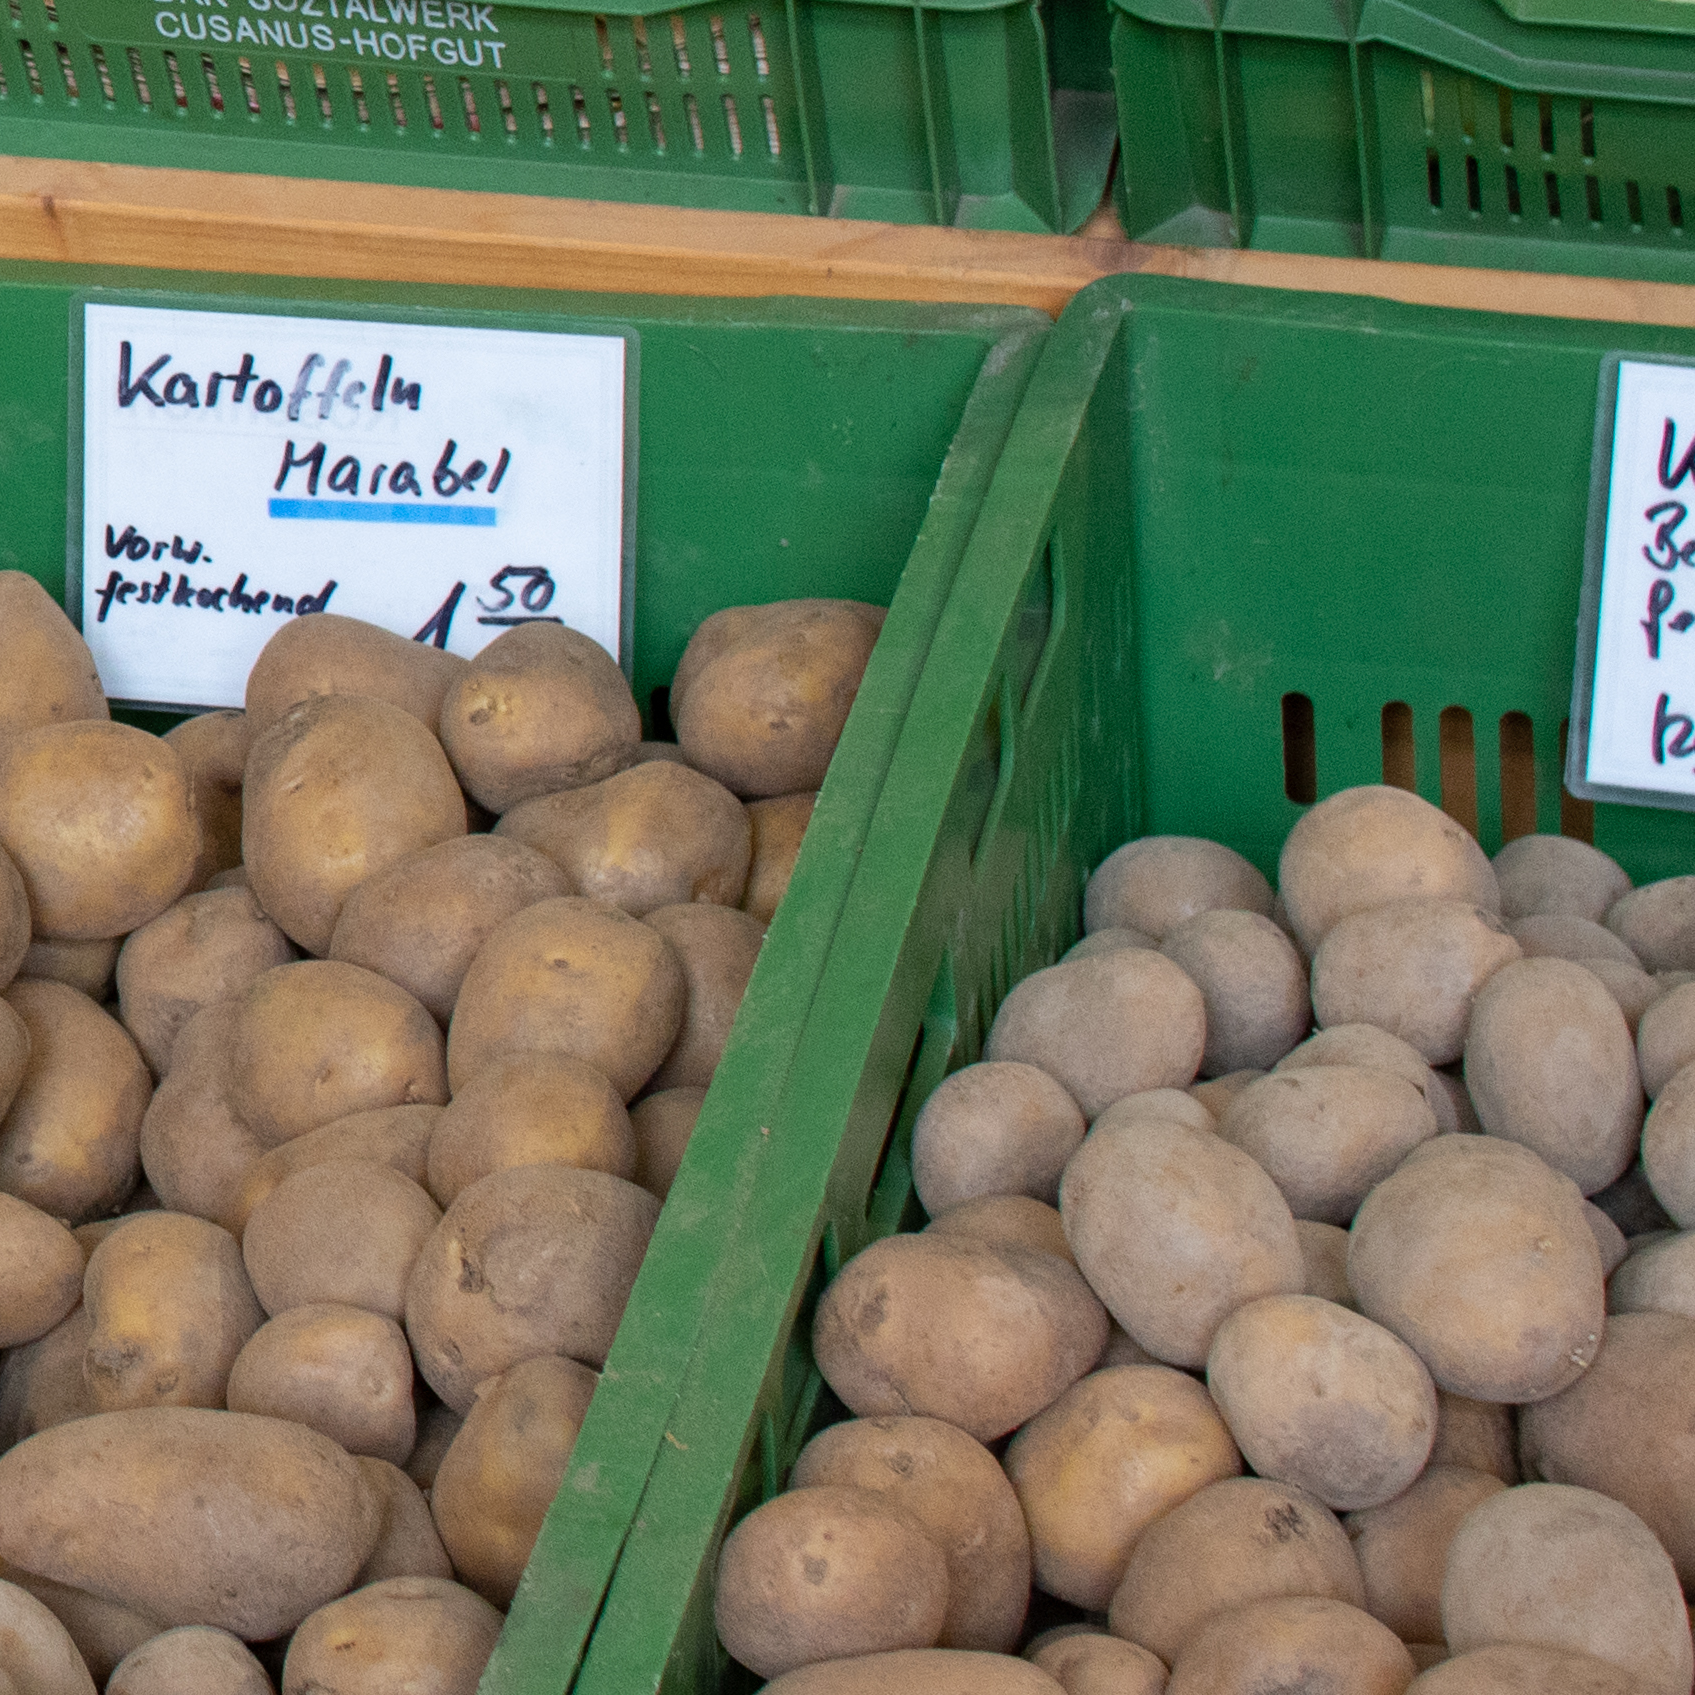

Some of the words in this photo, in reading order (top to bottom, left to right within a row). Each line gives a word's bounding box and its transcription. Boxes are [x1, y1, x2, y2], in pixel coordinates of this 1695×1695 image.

[154, 11, 507, 69] CUSANUS-HOFGUT
[117, 340, 423, 422] Kartoffeln
[273, 438, 511, 497] Marabel
